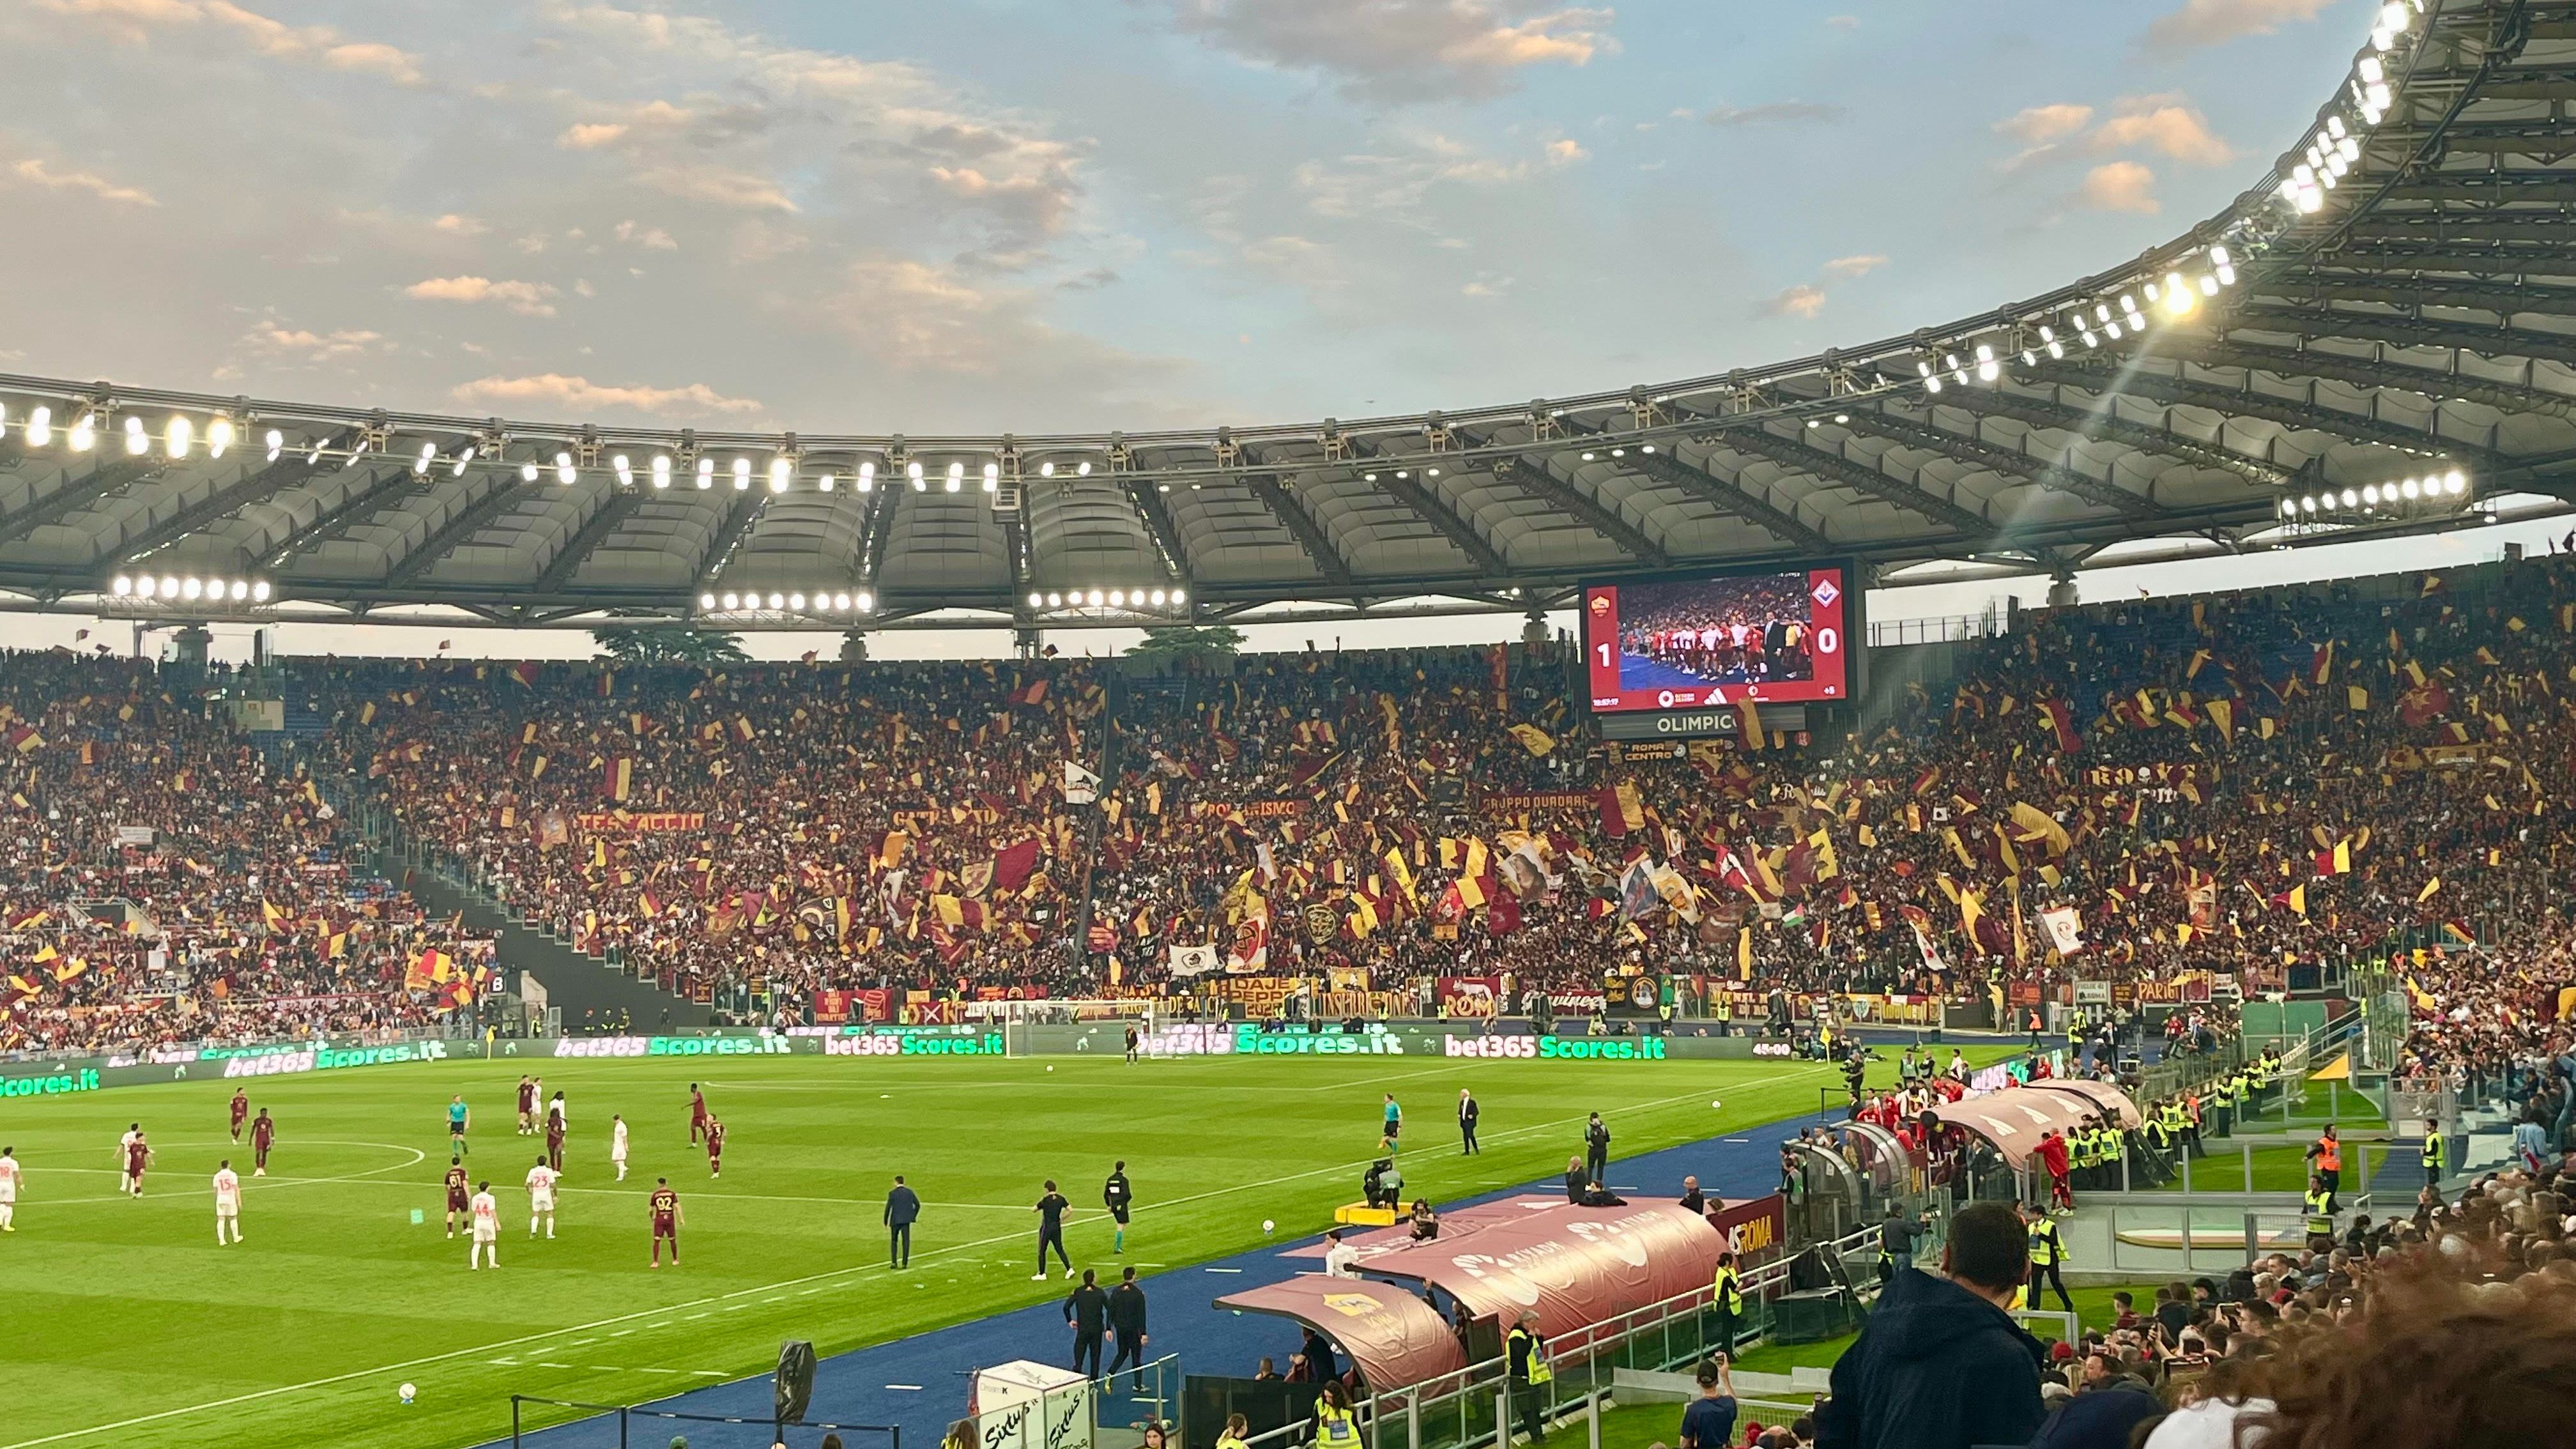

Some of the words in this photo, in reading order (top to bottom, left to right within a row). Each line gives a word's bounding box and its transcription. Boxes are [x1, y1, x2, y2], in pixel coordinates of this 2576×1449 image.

[1818, 627, 1837, 654] 0
[1597, 643, 1610, 668] 1
[1657, 715, 1737, 732] OLIMPIC
[1625, 751, 1673, 761] CENTRO
[1632, 743, 1666, 752] ROMA
[578, 813, 705, 831] TESACCIO
[493, 976, 503, 992] B
[1234, 978, 1290, 990] DAJE
[1445, 994, 1497, 1016] ROM
[554, 1036, 647, 1058] bet365
[648, 1035, 792, 1056] Scores.it
[824, 1034, 899, 1055] bet365
[901, 1033, 1004, 1055] Scores.it
[1235, 1032, 1404, 1055] Scores.it
[1444, 1034, 1536, 1058] bet365
[1539, 1035, 1666, 1059] Scores.it
[223, 1051, 315, 1079] bet365
[316, 1039, 447, 1070] Scores.it
[218, 1178, 231, 1192] 15
[534, 1175, 548, 1188] 23
[475, 1203, 490, 1217] 44
